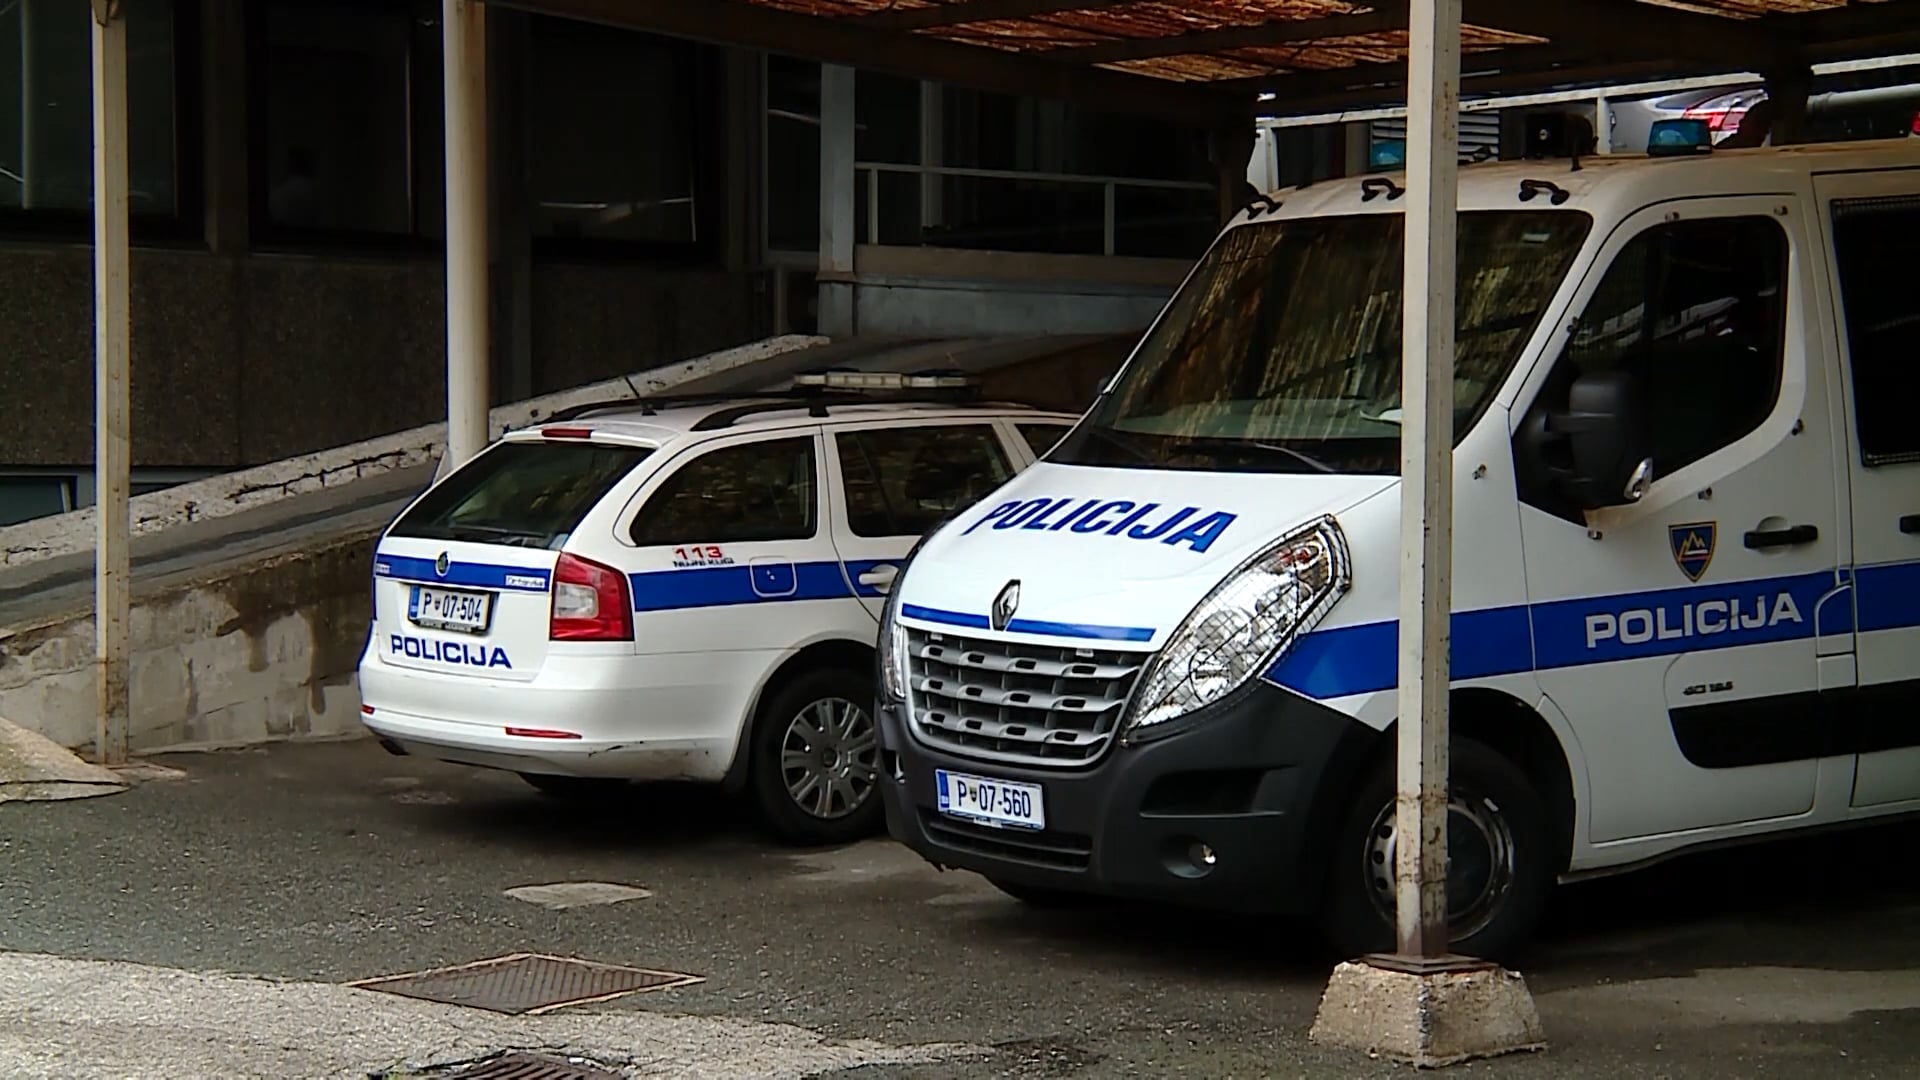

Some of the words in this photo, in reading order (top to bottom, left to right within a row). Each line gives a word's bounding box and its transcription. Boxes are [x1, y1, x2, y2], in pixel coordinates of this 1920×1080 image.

[959, 498, 1239, 554] POLICIJA
[674, 545, 723, 560] 113
[422, 592, 433, 615] P
[442, 594, 483, 622] 07-504
[1585, 592, 1803, 649] POLICIJA
[390, 634, 513, 669] POLICIJA
[957, 780, 968, 807] P
[979, 783, 1031, 818] 07-560
